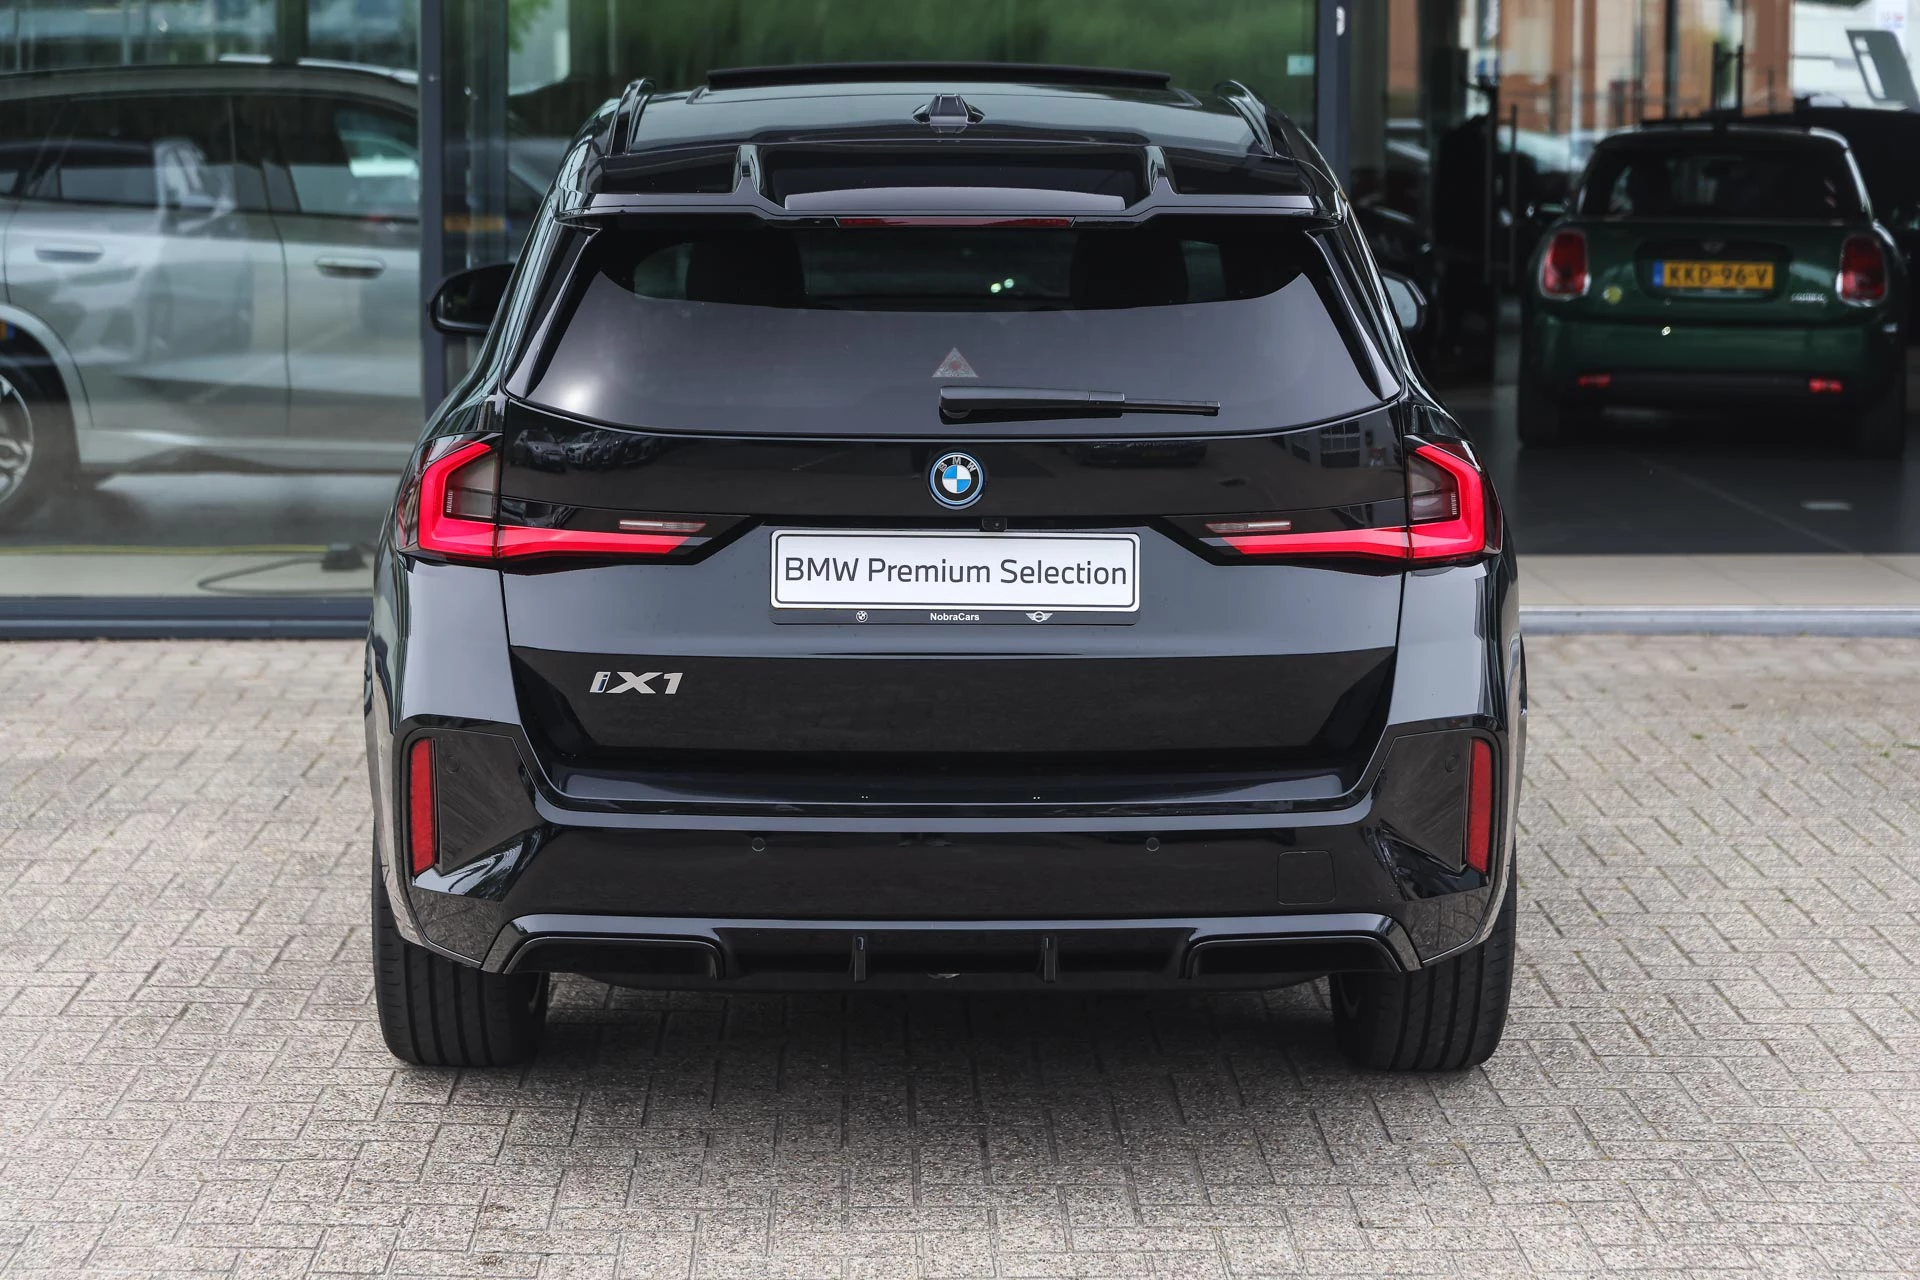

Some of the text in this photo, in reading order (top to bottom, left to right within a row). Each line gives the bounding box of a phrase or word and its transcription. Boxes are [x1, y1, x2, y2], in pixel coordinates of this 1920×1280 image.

[1668, 264, 1768, 285] KKD-96-V
[937, 456, 977, 472] BMW
[785, 557, 1127, 585] BMW Premium Selection
[930, 612, 980, 622] NobraCars
[589, 671, 684, 695] iX1
